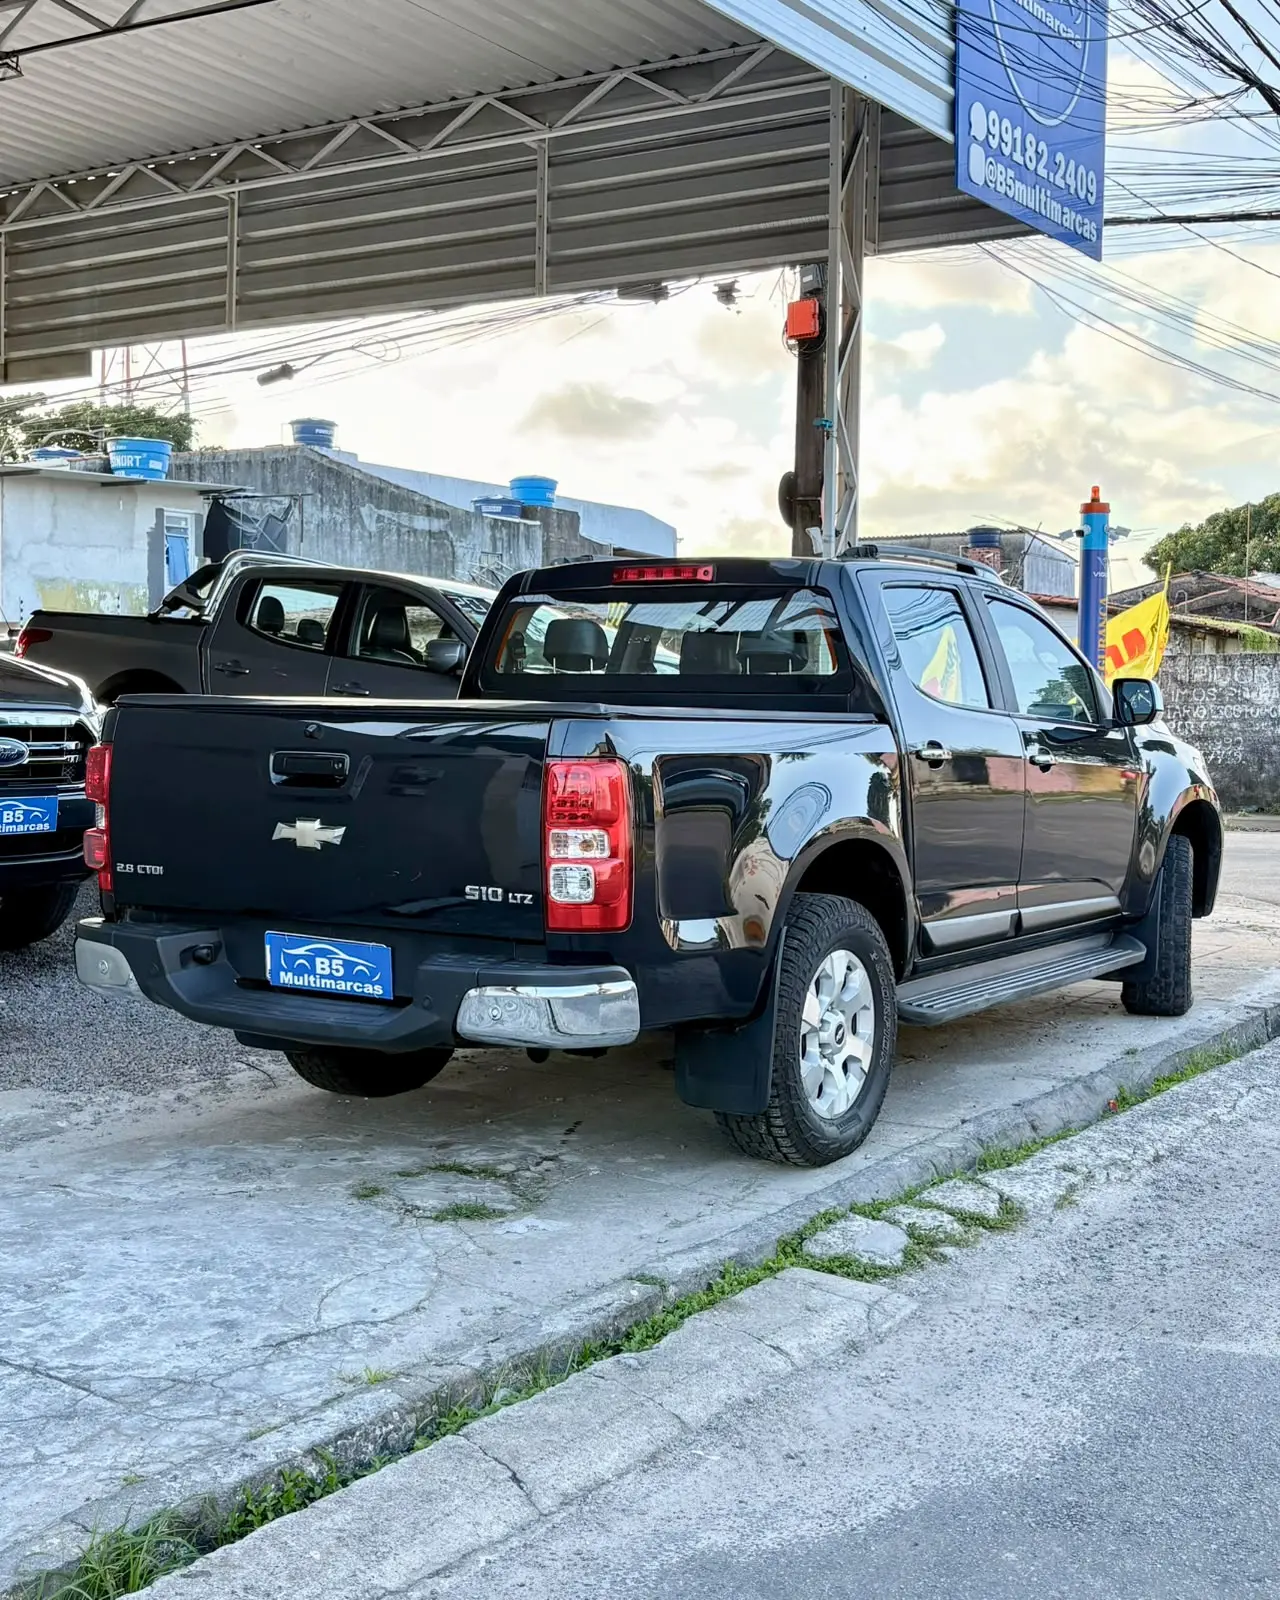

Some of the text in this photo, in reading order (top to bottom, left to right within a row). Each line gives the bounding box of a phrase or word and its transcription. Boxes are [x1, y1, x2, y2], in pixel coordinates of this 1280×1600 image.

[987, 110, 1097, 206] 99182.2409
[985, 157, 1097, 242] @B5multimarcas
[2, 809, 24, 824] B5
[0, 823, 50, 833] imarcas
[465, 885, 533, 905] S10 LTZ
[315, 957, 345, 977] B5
[279, 970, 384, 995] Multimarcas
